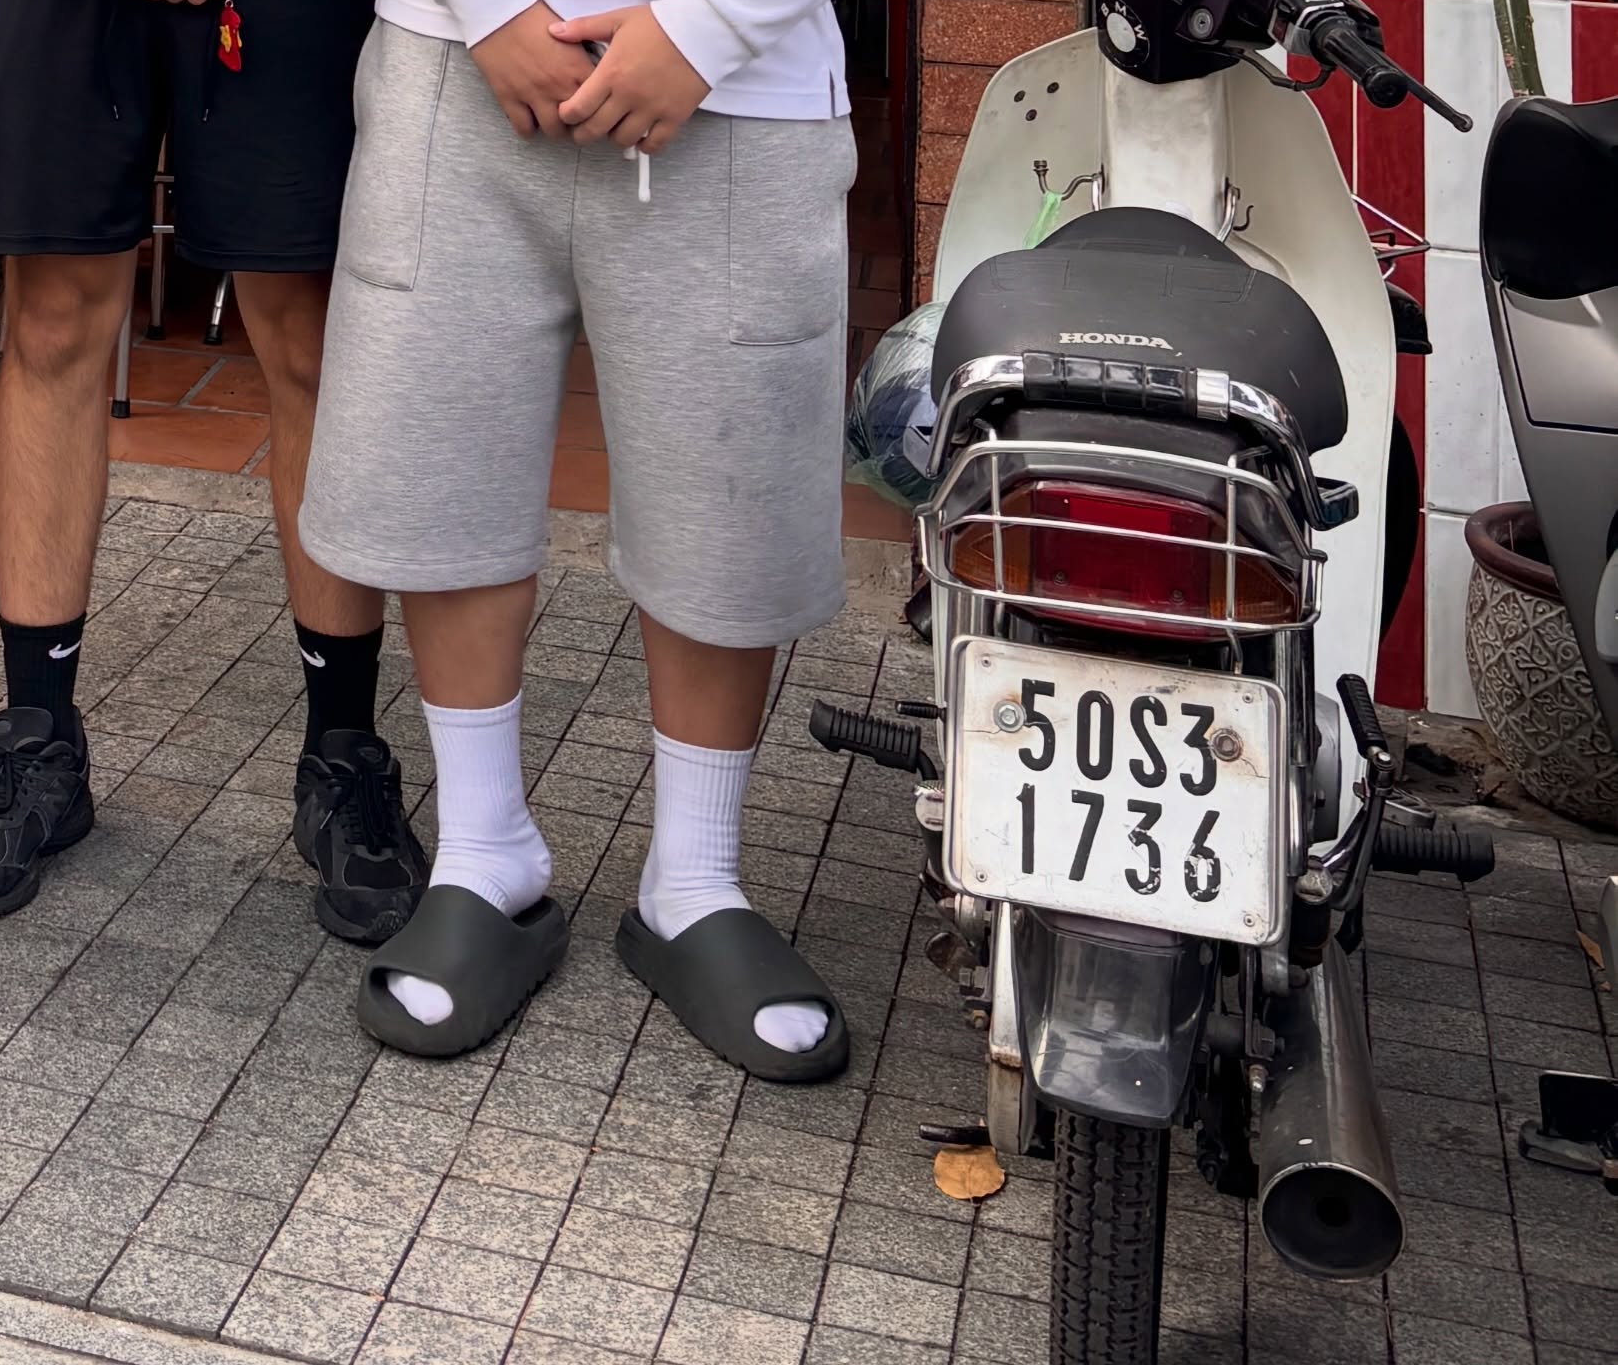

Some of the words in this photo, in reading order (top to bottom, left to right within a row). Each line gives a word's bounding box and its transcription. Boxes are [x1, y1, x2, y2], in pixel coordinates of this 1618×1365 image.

[1059, 332, 1174, 350] HONDA
[1018, 678, 1218, 797] 50S3
[1015, 782, 1222, 903] 1736
